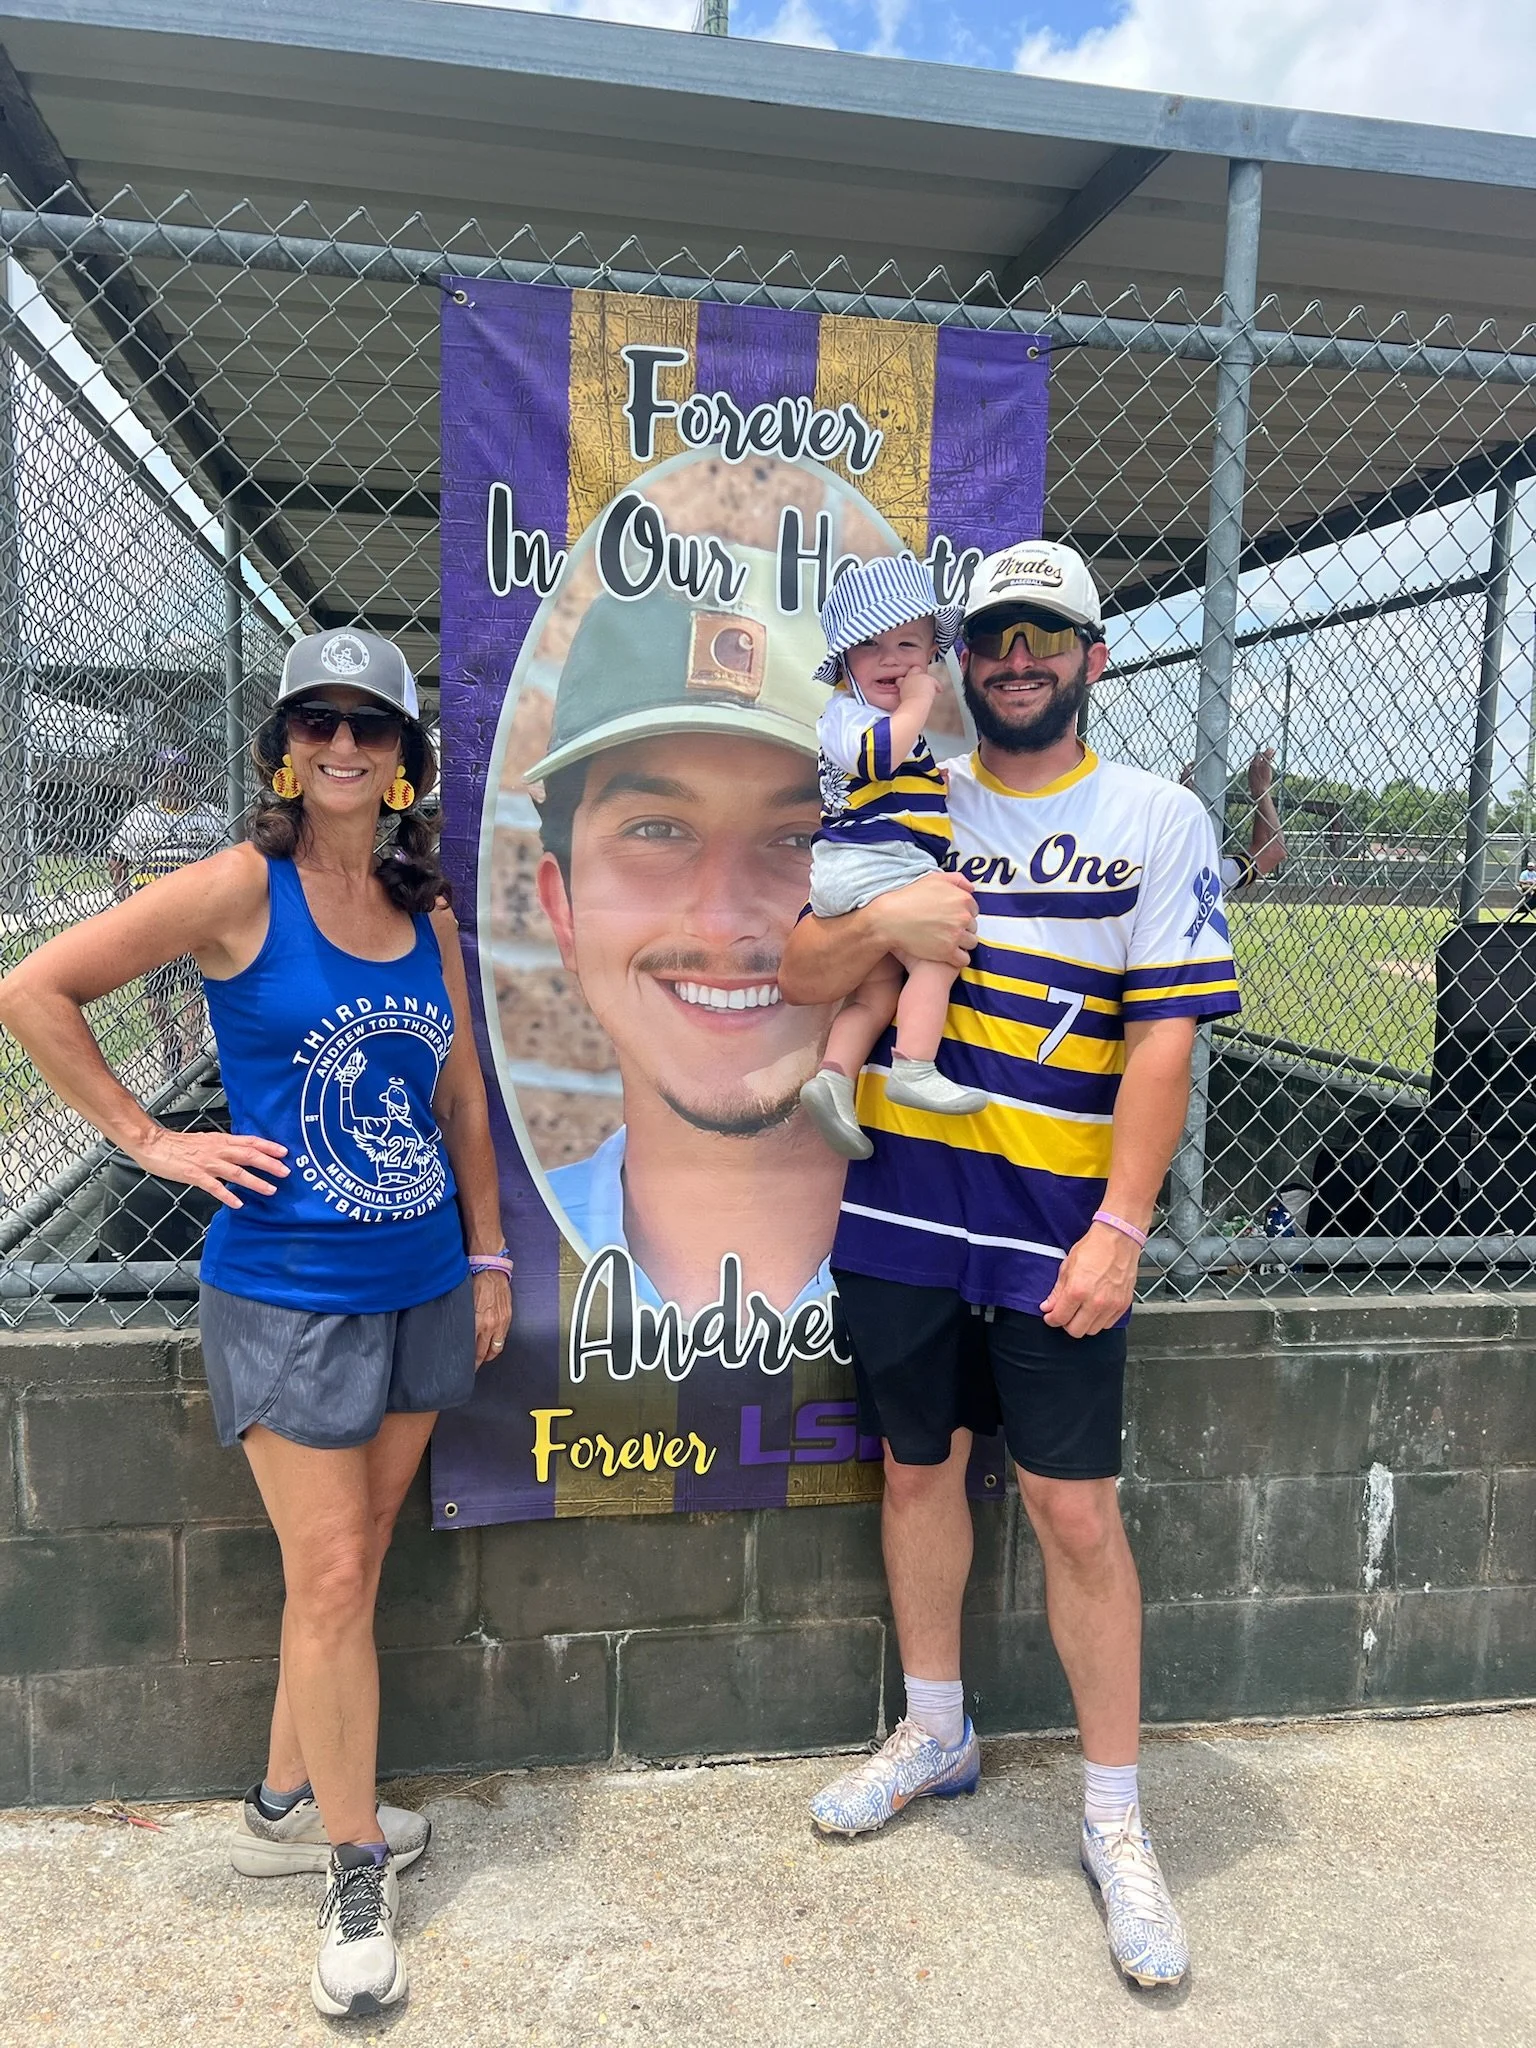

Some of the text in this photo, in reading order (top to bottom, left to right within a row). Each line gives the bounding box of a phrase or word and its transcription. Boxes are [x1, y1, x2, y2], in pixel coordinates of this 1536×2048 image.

[621, 345, 884, 474] Forever
[486, 482, 984, 618] In Our Hts
[990, 555, 1062, 582] Pirates
[1030, 832, 1142, 887] One
[292, 997, 372, 1065] THIRD
[315, 1024, 365, 1078] ANDREW
[369, 1017, 398, 1031] TOD
[1037, 986, 1085, 1065] 7
[305, 1114, 320, 1122] EST
[326, 1163, 392, 1205] MEMORIAL
[384, 1136, 418, 1169] 27
[295, 1154, 383, 1223] SOFTBALL
[529, 1401, 884, 1483] Forever LS
